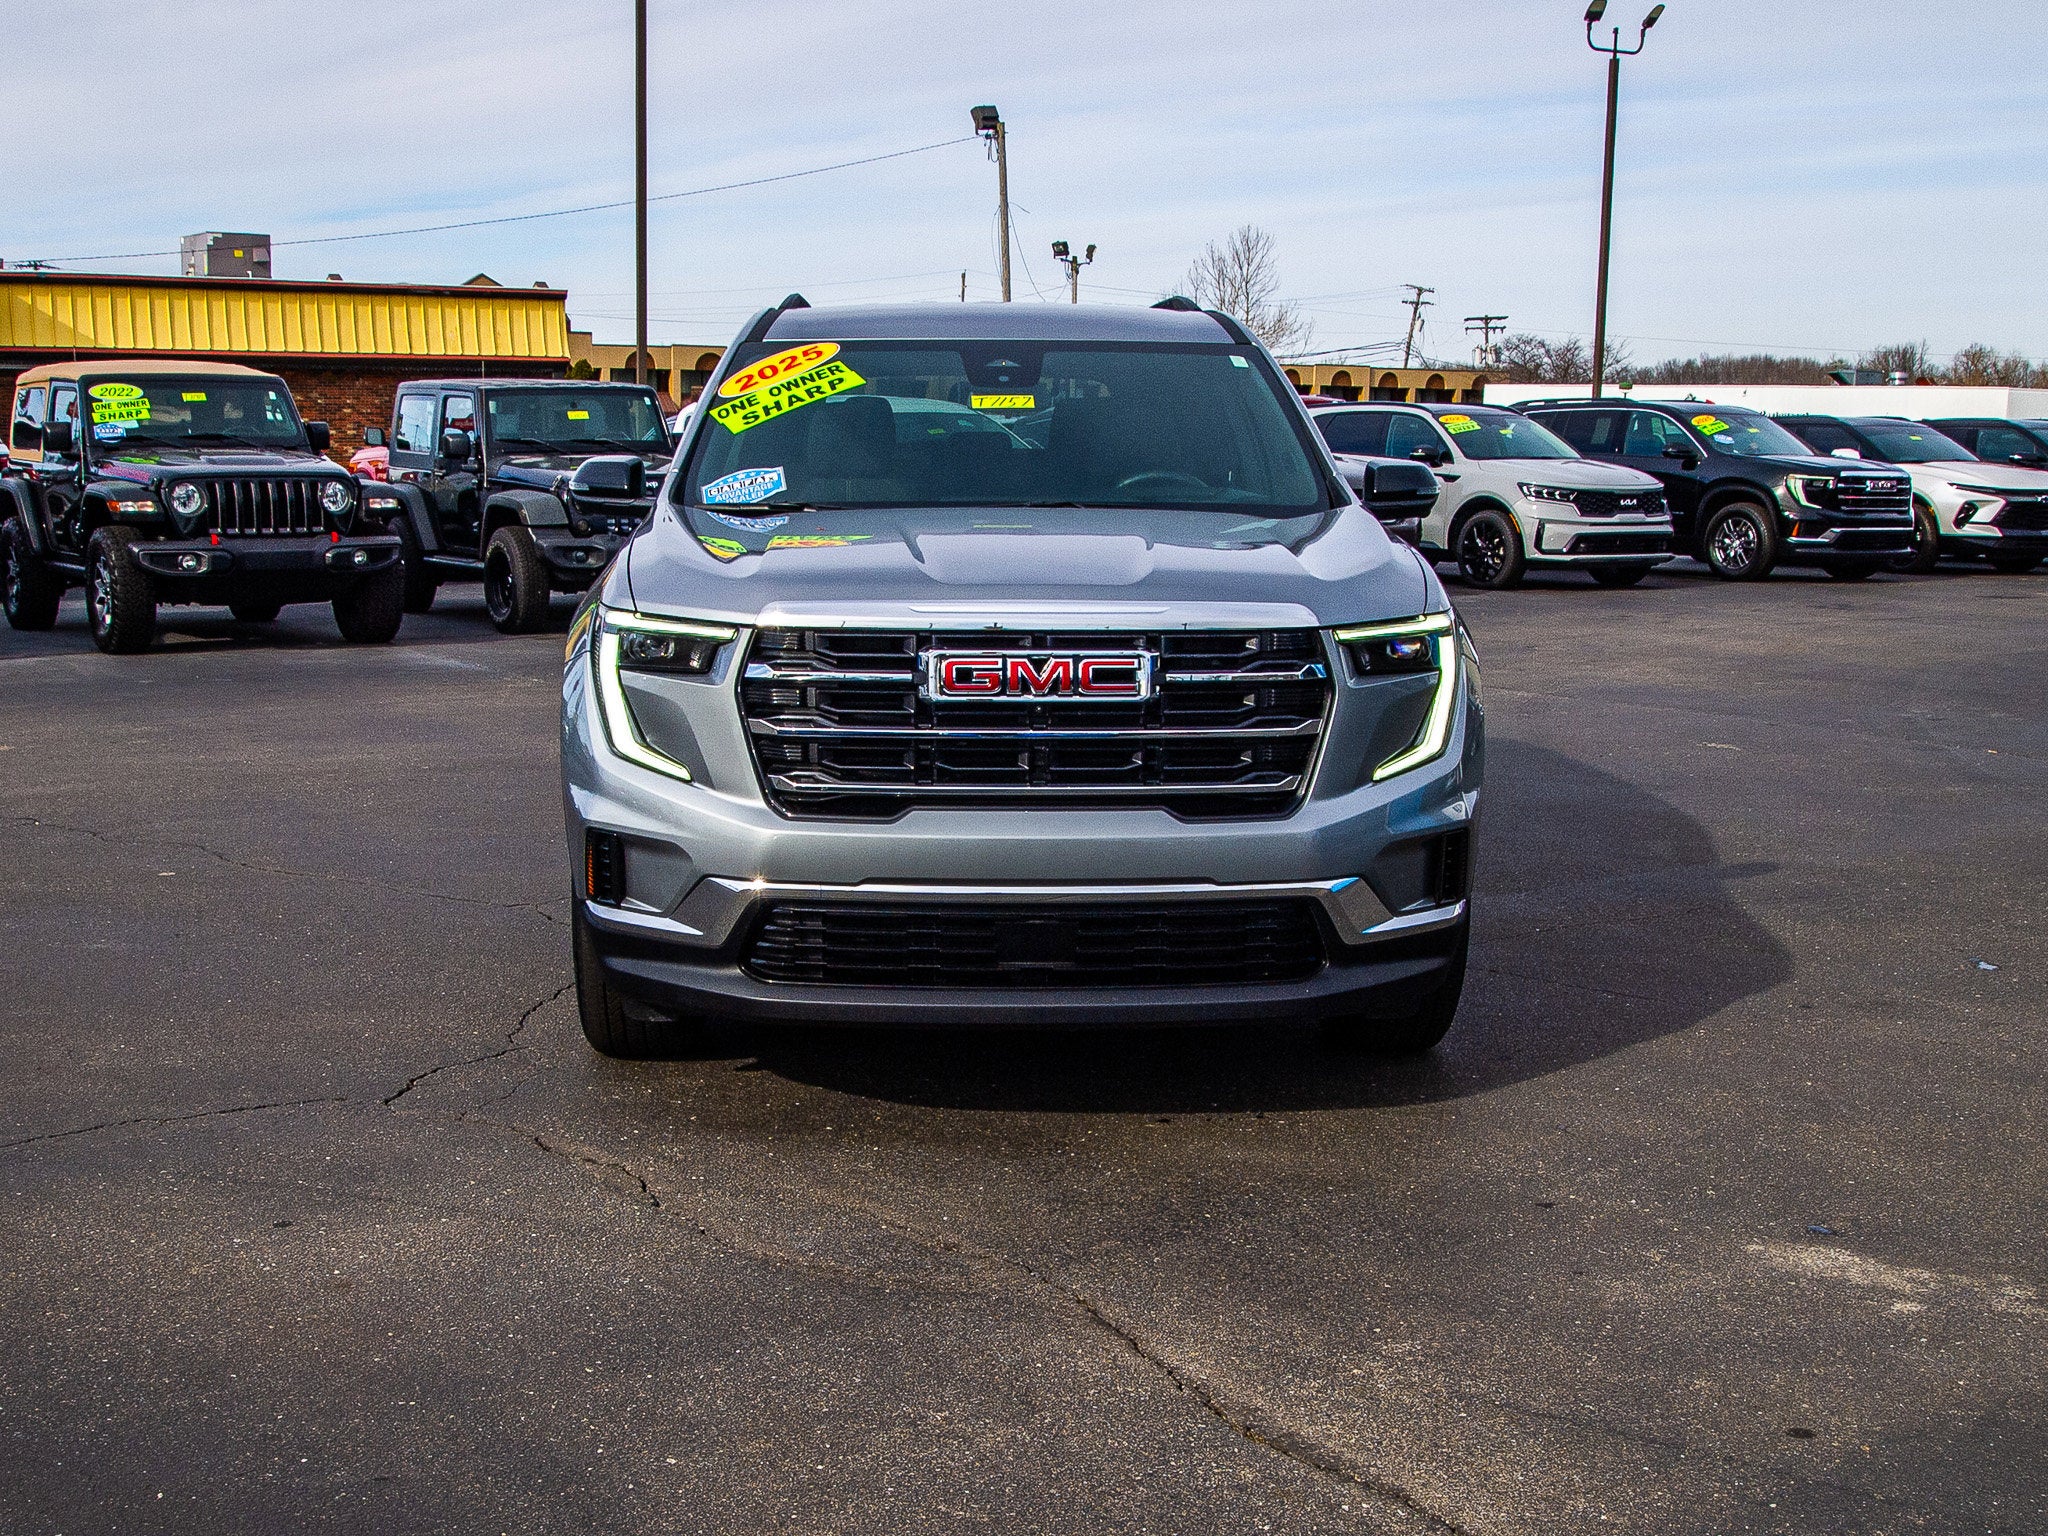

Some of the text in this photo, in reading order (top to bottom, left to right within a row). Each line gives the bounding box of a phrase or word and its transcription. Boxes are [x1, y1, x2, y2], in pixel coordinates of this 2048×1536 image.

[735, 346, 823, 392] 2025
[95, 399, 148, 411] ONE OWNER
[100, 387, 134, 397] 2022
[717, 364, 845, 419] ONE OWNER
[741, 377, 845, 425] SHARP
[99, 410, 142, 421] SHARP
[941, 656, 1141, 695] GMC
